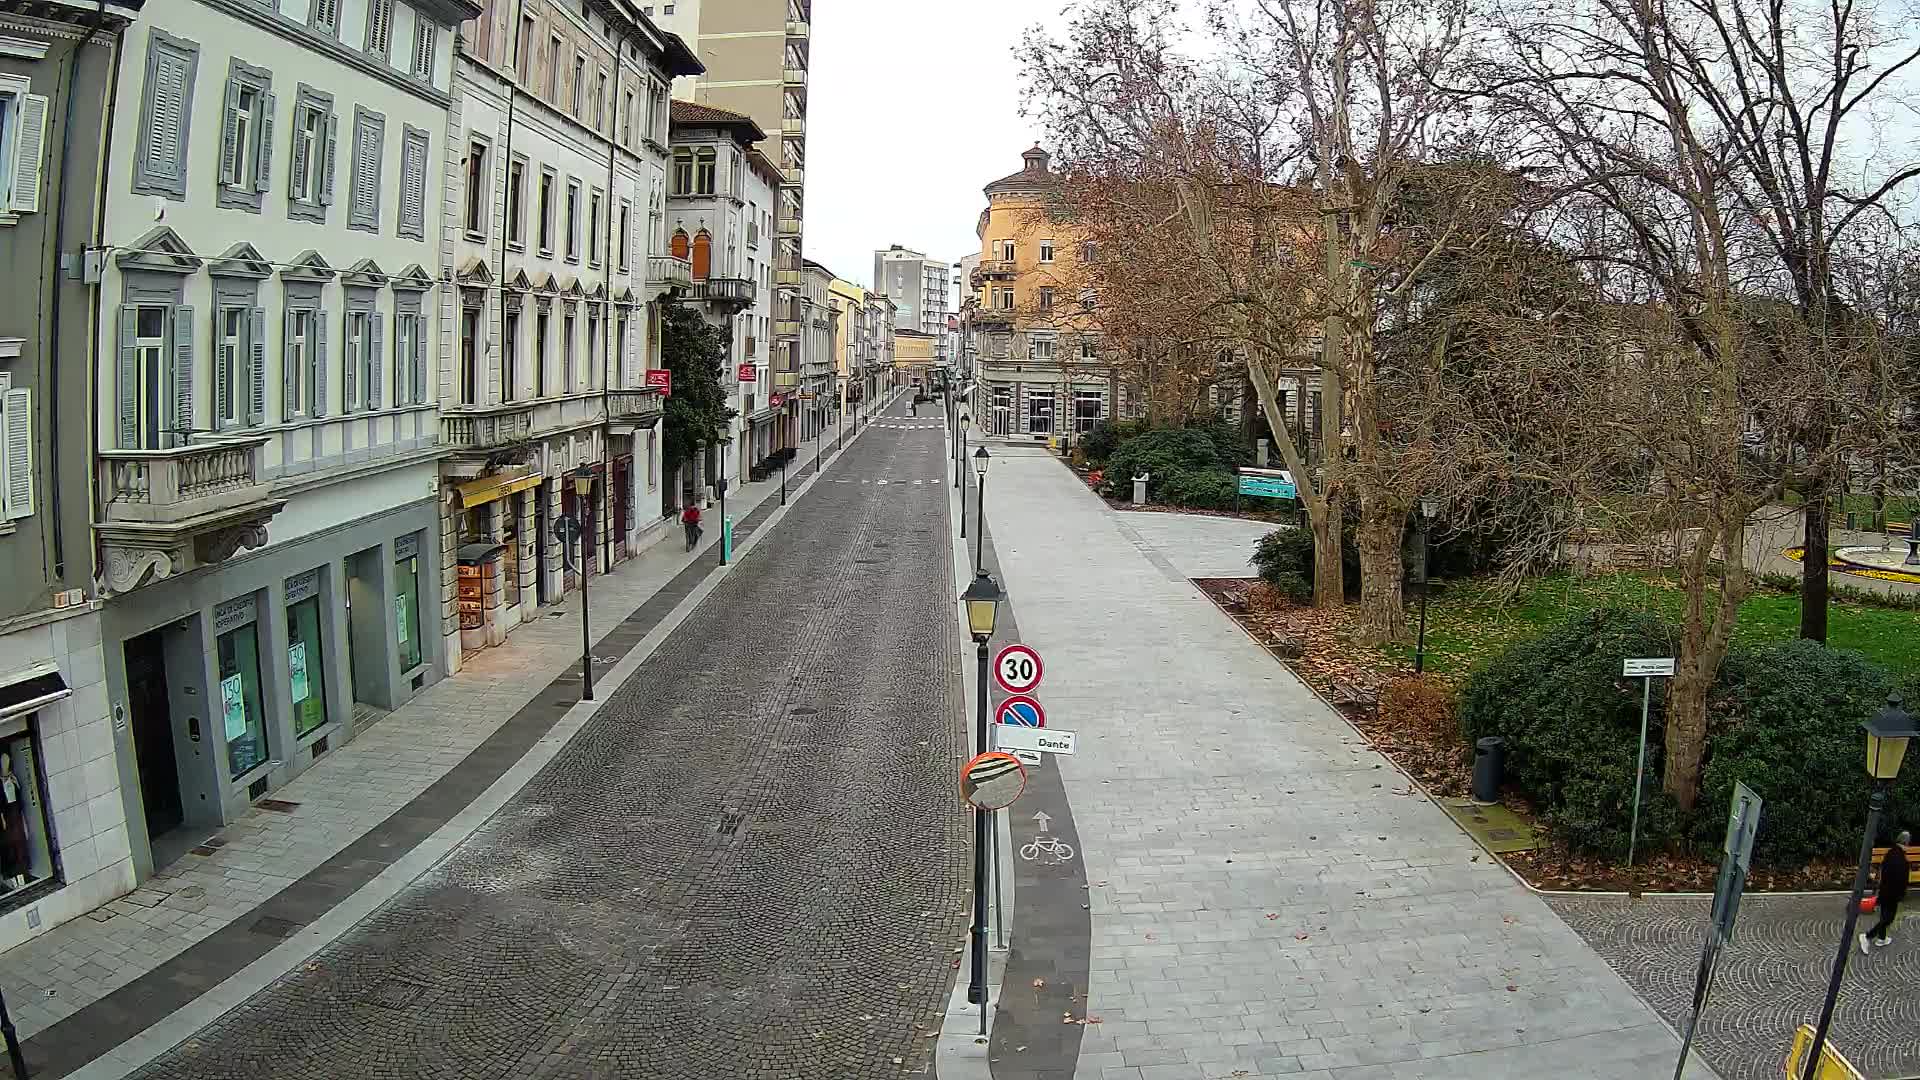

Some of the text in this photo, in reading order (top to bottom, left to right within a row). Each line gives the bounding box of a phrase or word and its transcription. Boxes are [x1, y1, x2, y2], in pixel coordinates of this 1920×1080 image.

[1005, 658, 1033, 680] 30
[222, 676, 240, 700] 130
[1038, 738, 1070, 749] Dante
